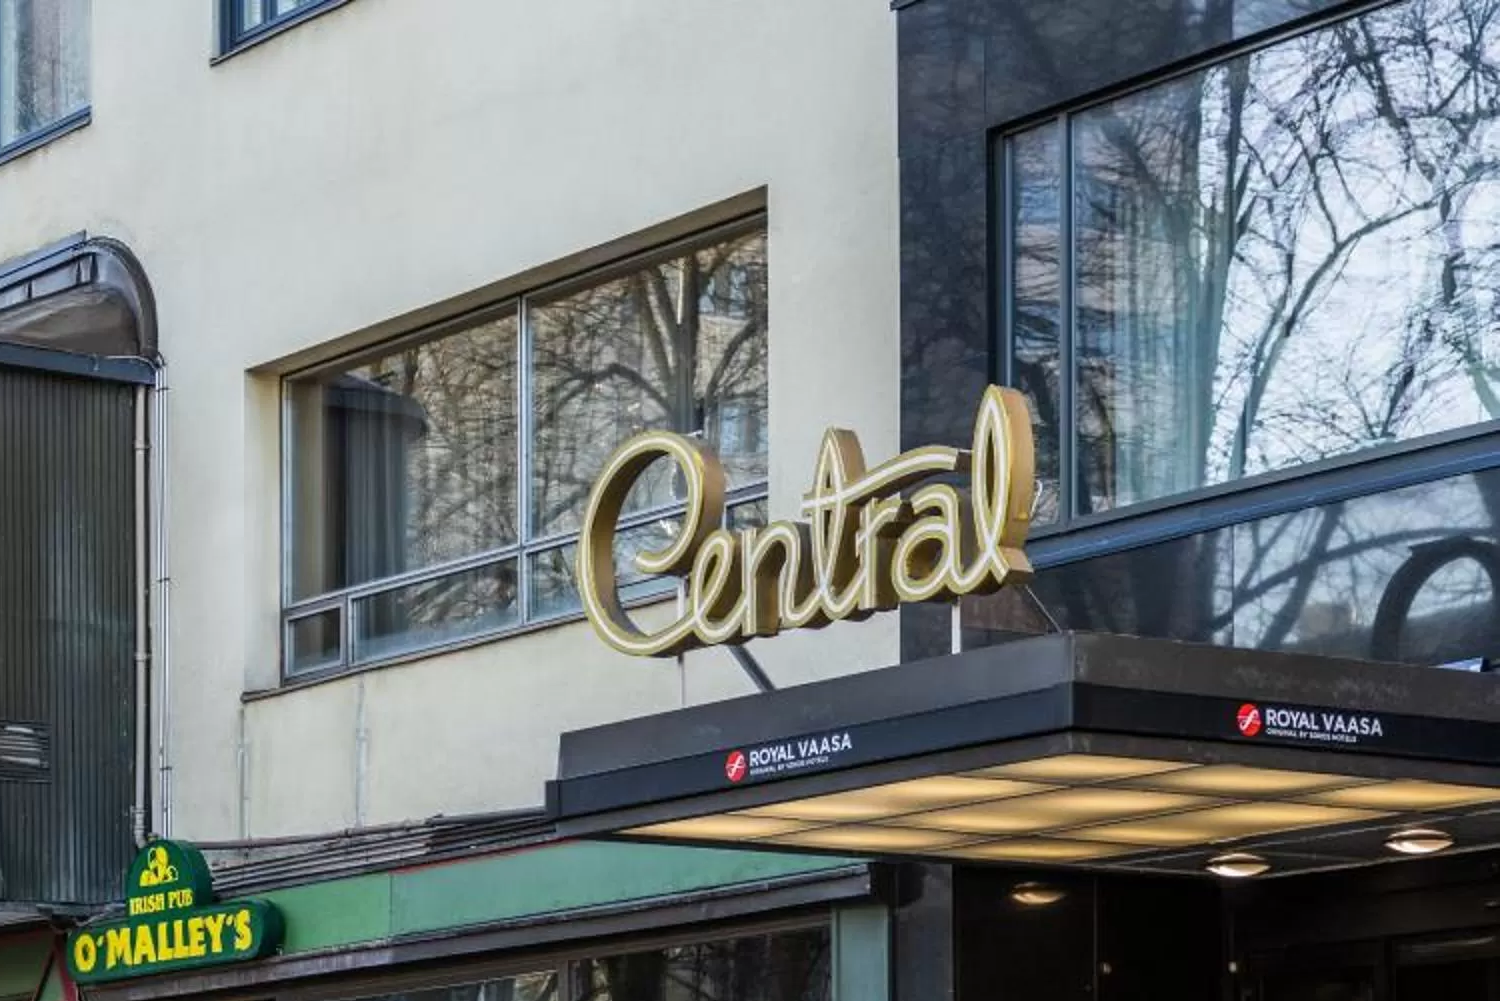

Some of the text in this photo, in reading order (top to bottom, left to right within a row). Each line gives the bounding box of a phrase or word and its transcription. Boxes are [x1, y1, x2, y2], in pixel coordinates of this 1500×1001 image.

[577, 385, 1034, 657] Central
[1265, 709, 1383, 736] ROYAL VAASA
[750, 732, 852, 767] ROYAL VAASA
[130, 888, 194, 916] IRISH PUB
[74, 909, 252, 973] O'MALLEY'S
